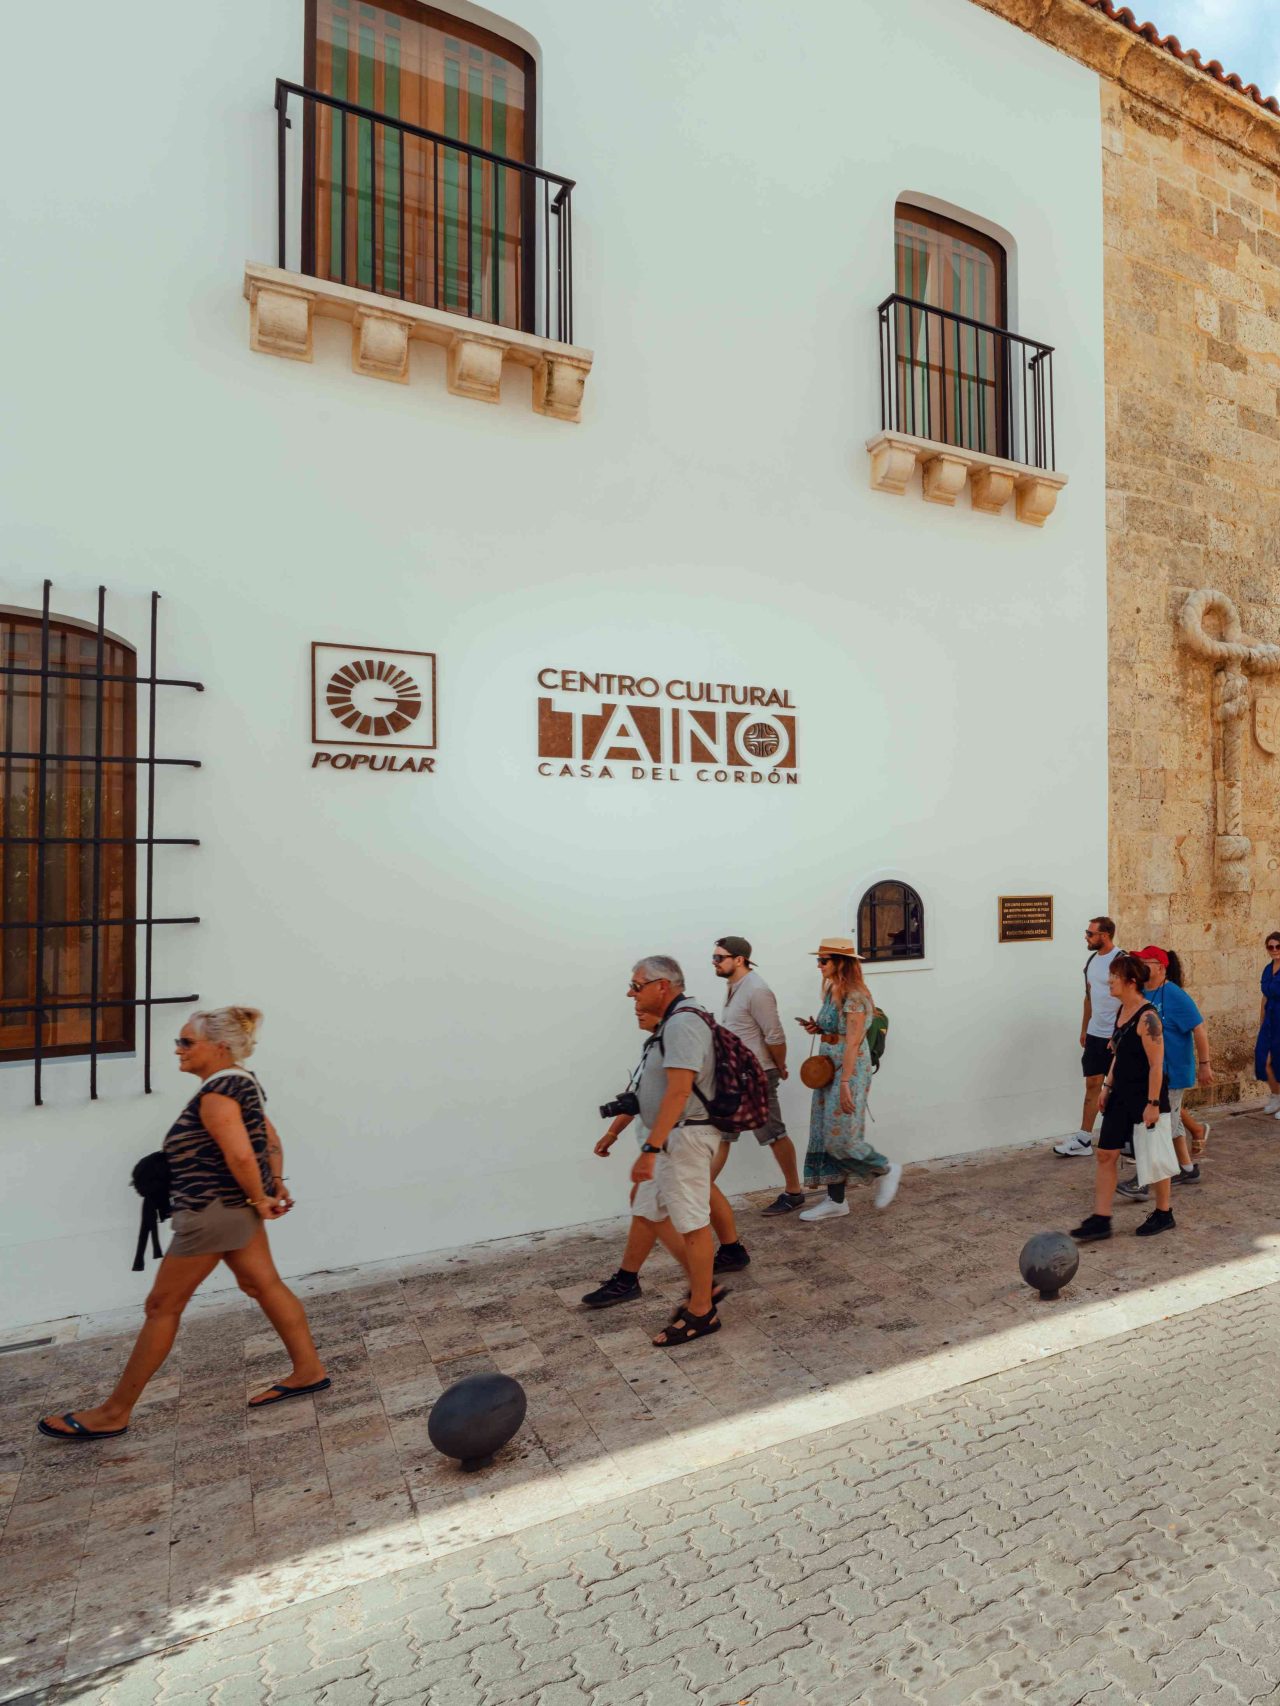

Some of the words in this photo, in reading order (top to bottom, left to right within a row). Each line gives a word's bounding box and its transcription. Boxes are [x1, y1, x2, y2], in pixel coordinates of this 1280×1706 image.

[537, 668, 660, 698] CENTRO
[665, 679, 797, 709] CULTURAL
[538, 697, 797, 768] TAINO
[311, 752, 436, 773] POPULAR
[538, 762, 613, 779] CASA
[631, 766, 680, 781] DEL
[696, 768, 798, 784] CORDÓN
